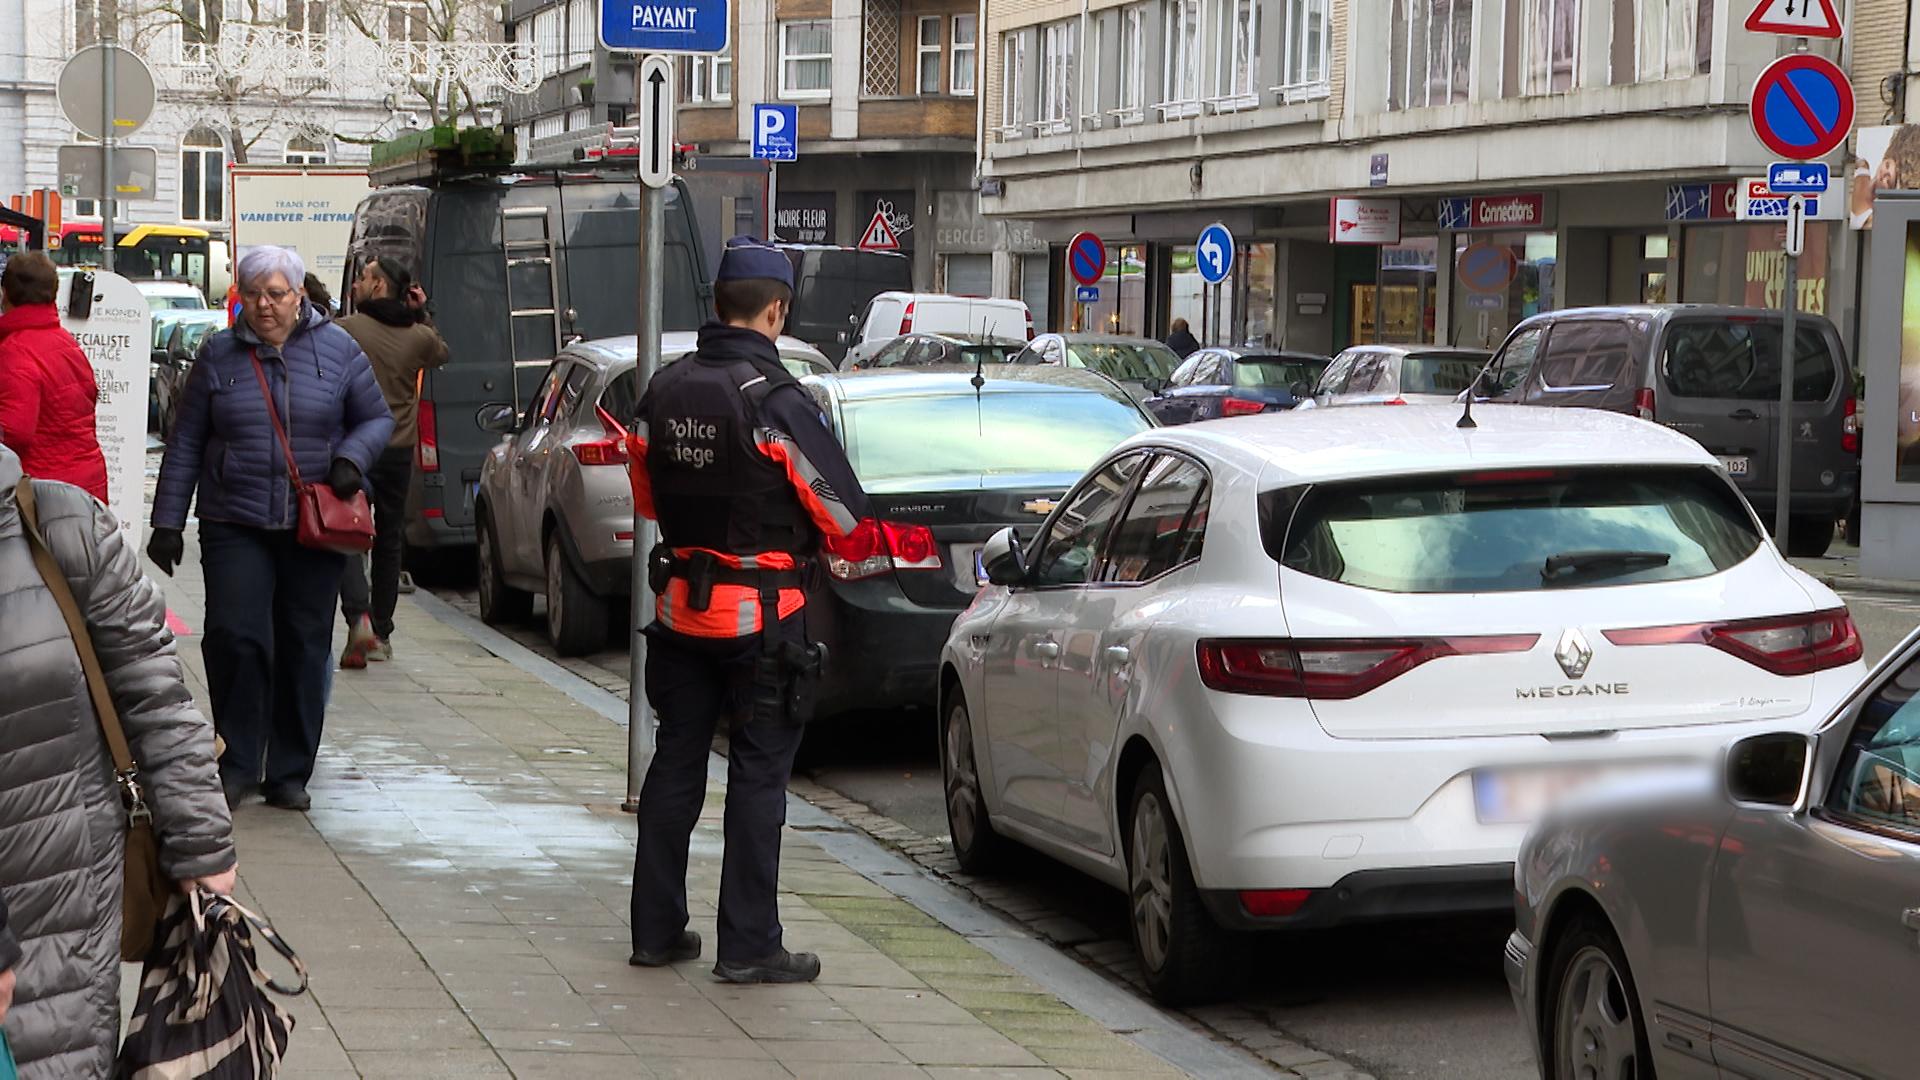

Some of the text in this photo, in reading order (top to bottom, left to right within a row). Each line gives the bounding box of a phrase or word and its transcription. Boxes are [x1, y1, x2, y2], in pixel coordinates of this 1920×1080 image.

[632, 5, 697, 28] PAYANT
[758, 109, 785, 146] P
[240, 213, 304, 222] VANBEVER
[778, 209, 827, 228] NOIRE FLEUR
[1480, 199, 1534, 223] Connections
[937, 228, 985, 245] CERCLE
[1746, 251, 1788, 282] UNITE
[1764, 277, 1826, 315] STTES
[665, 417, 717, 439] Police
[1727, 461, 1746, 472] 102
[1516, 683, 1630, 699] MEGANE
